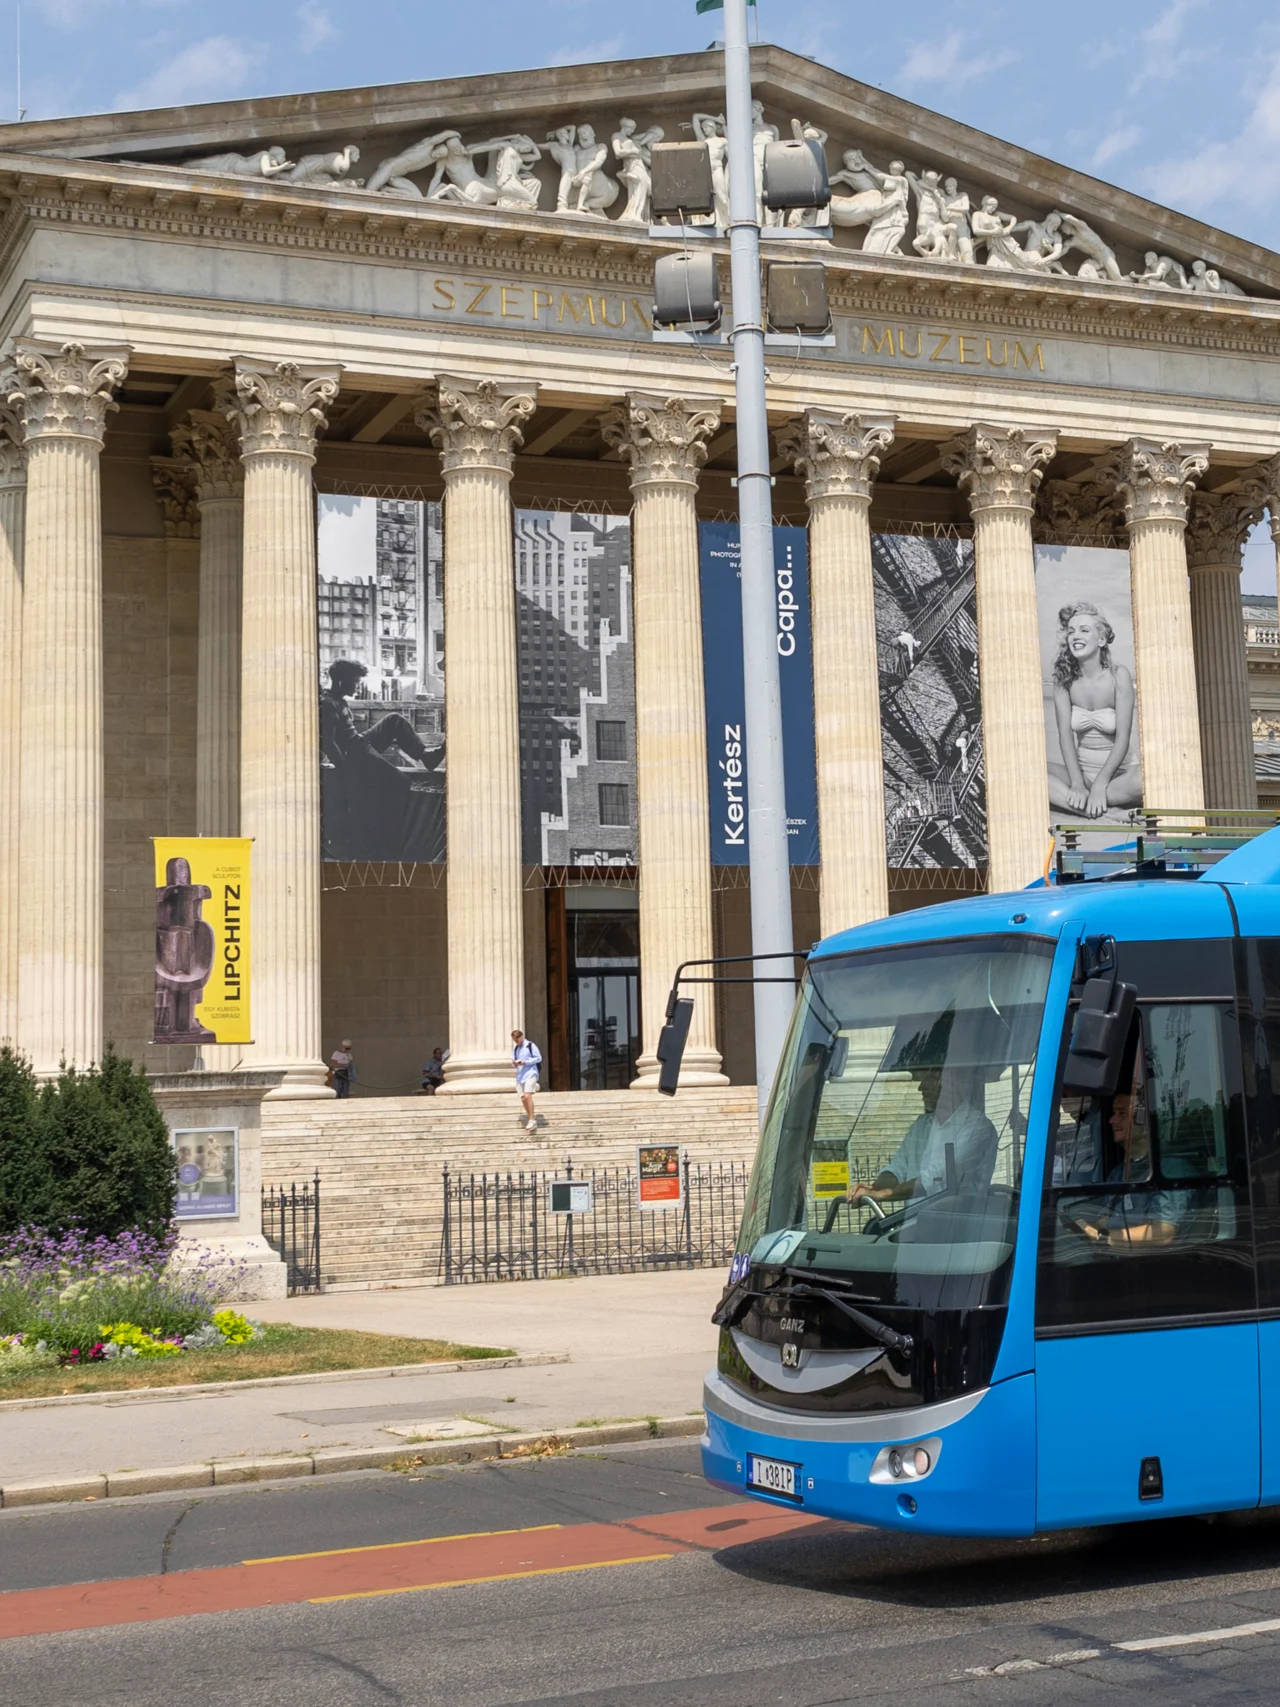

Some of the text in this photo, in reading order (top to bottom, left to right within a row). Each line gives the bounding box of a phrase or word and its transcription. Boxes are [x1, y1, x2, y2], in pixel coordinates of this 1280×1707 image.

[718, 724, 745, 845] Kertész
[224, 884, 241, 1001] LIPCHITZ
[780, 1317, 805, 1333] GANZ
